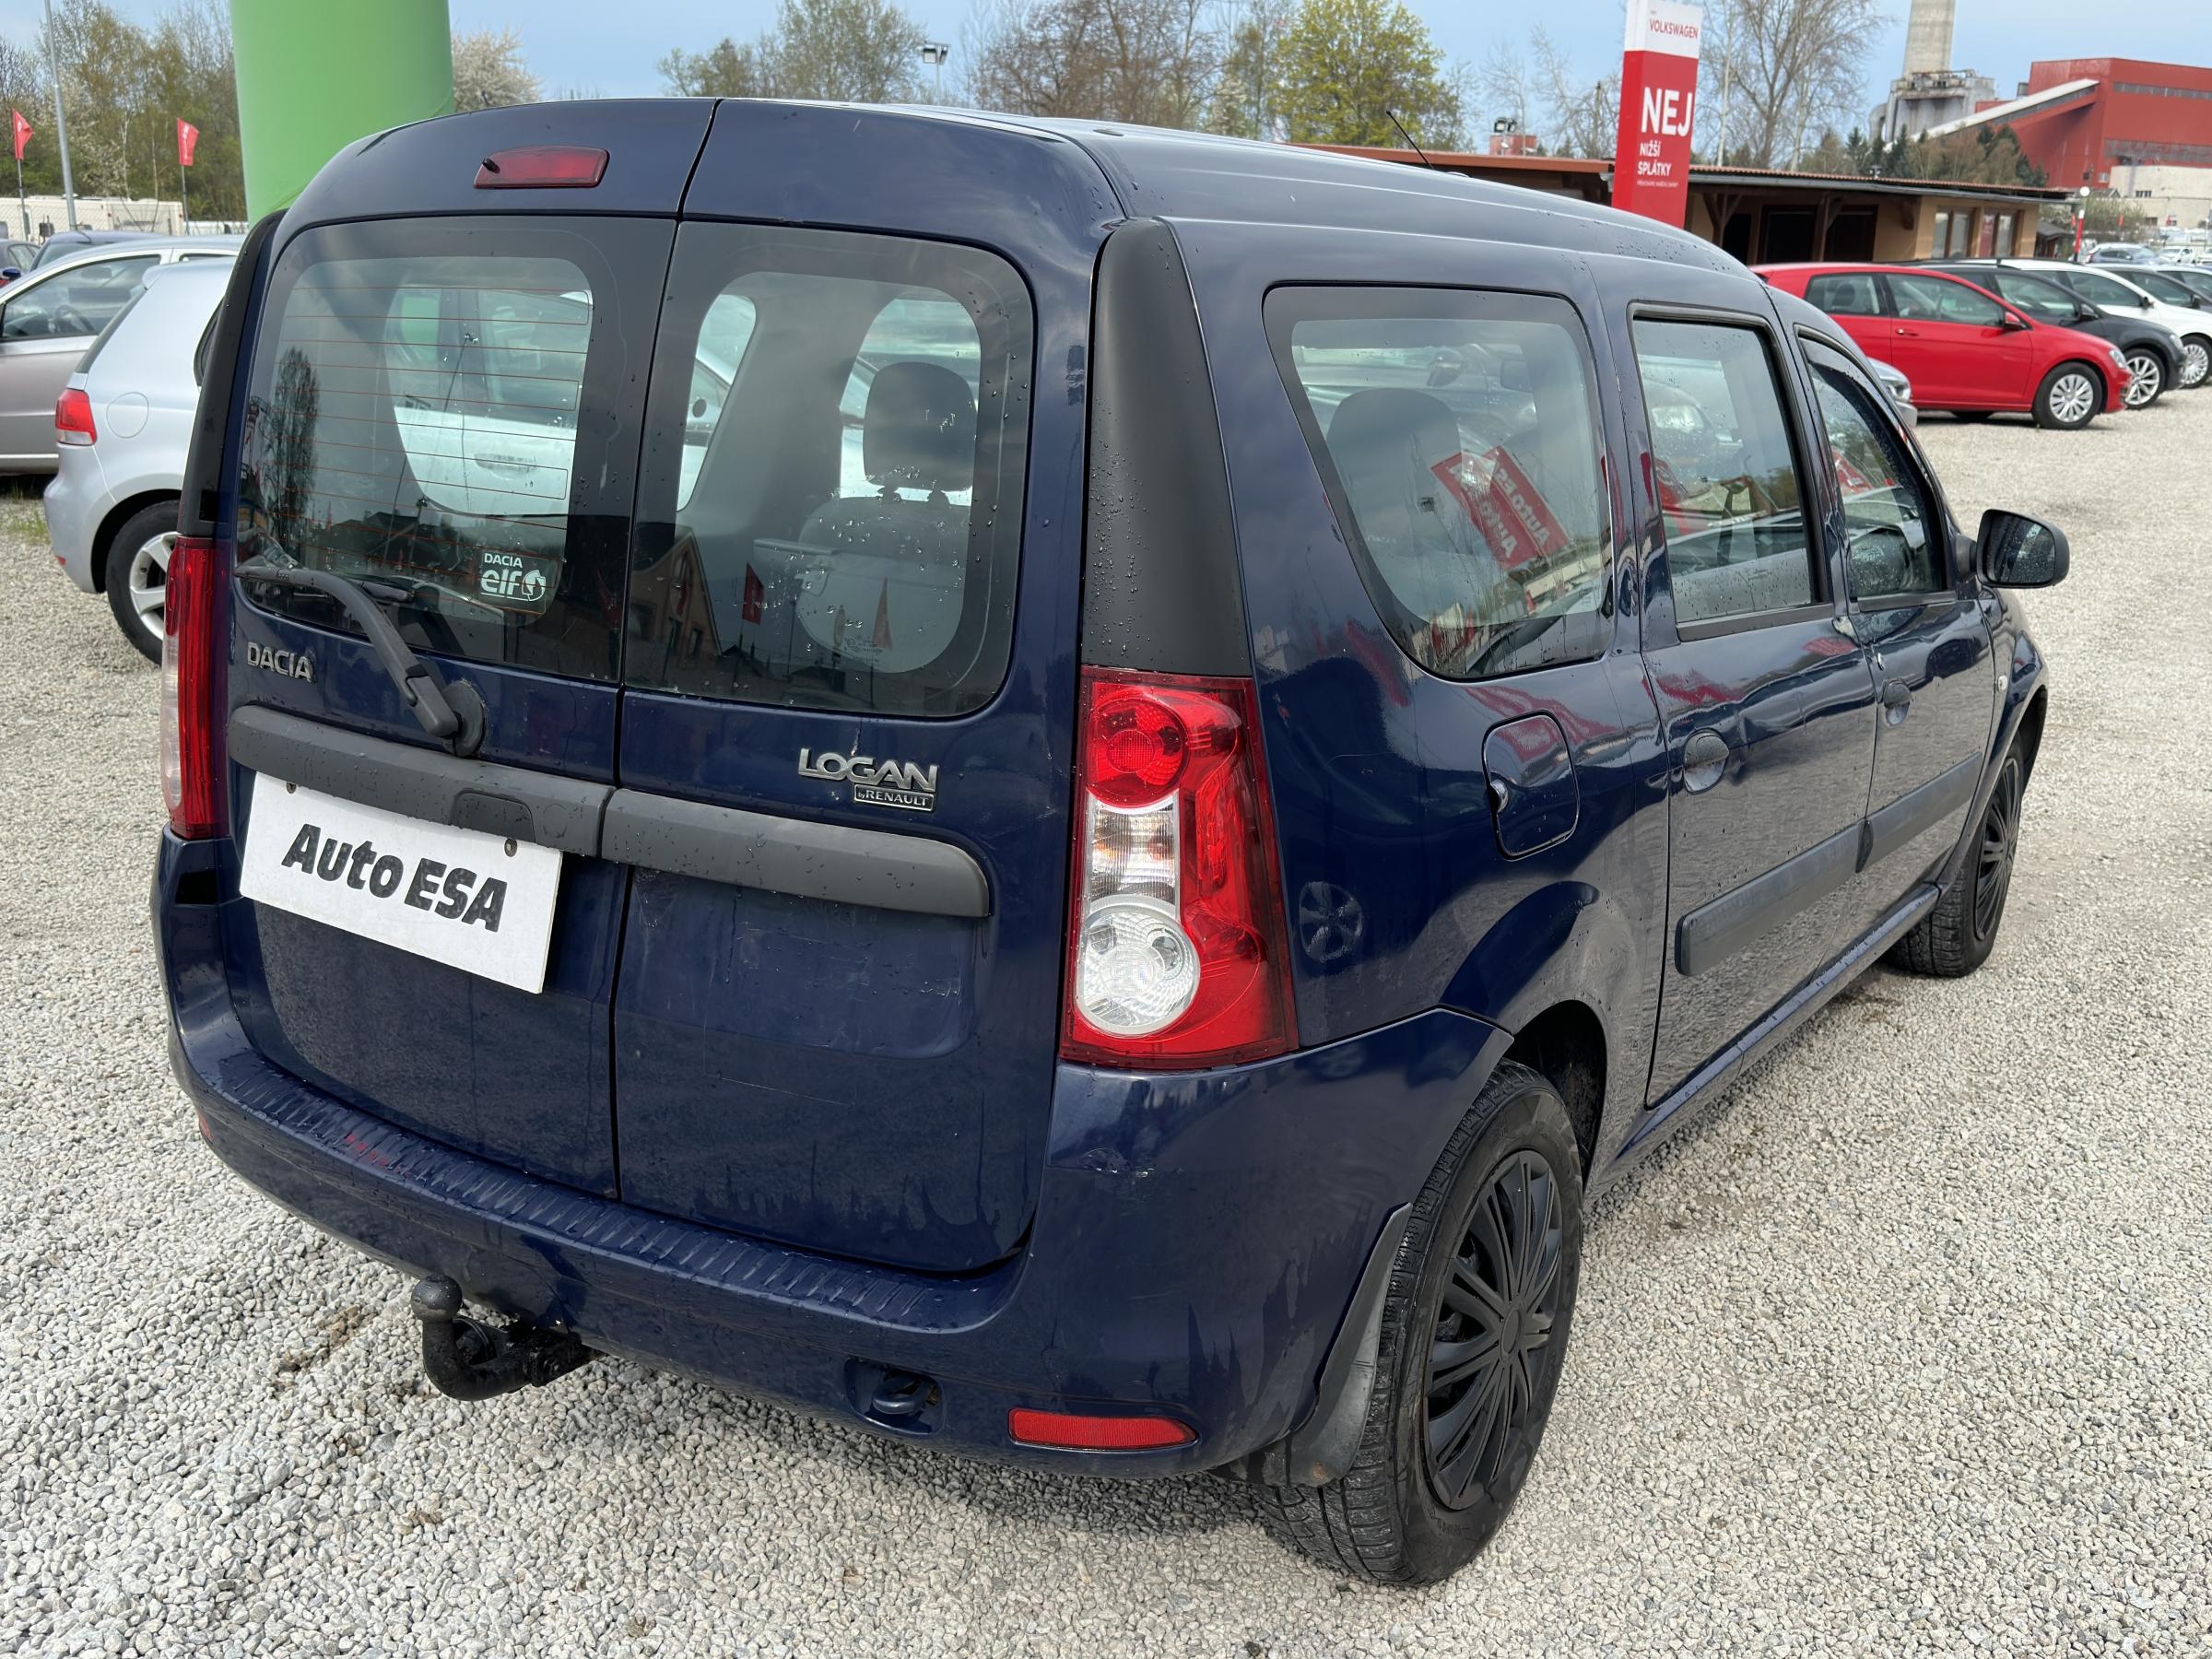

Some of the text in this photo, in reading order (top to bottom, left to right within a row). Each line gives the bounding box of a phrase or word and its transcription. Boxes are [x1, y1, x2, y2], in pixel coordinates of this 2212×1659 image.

[1650, 18, 1699, 39] VOLKSWAGEN
[1641, 87, 1693, 136] NEJ
[1640, 139, 1662, 158] NIŽŠÍ
[1637, 159, 1672, 177] SPLÁTKY
[484, 553, 524, 568] DACIA
[480, 569, 523, 595] elf
[247, 641, 315, 683] DACIA
[797, 747, 939, 793] LOGAN
[865, 790, 929, 806] RENAULT
[281, 823, 507, 933] Auto ESA
